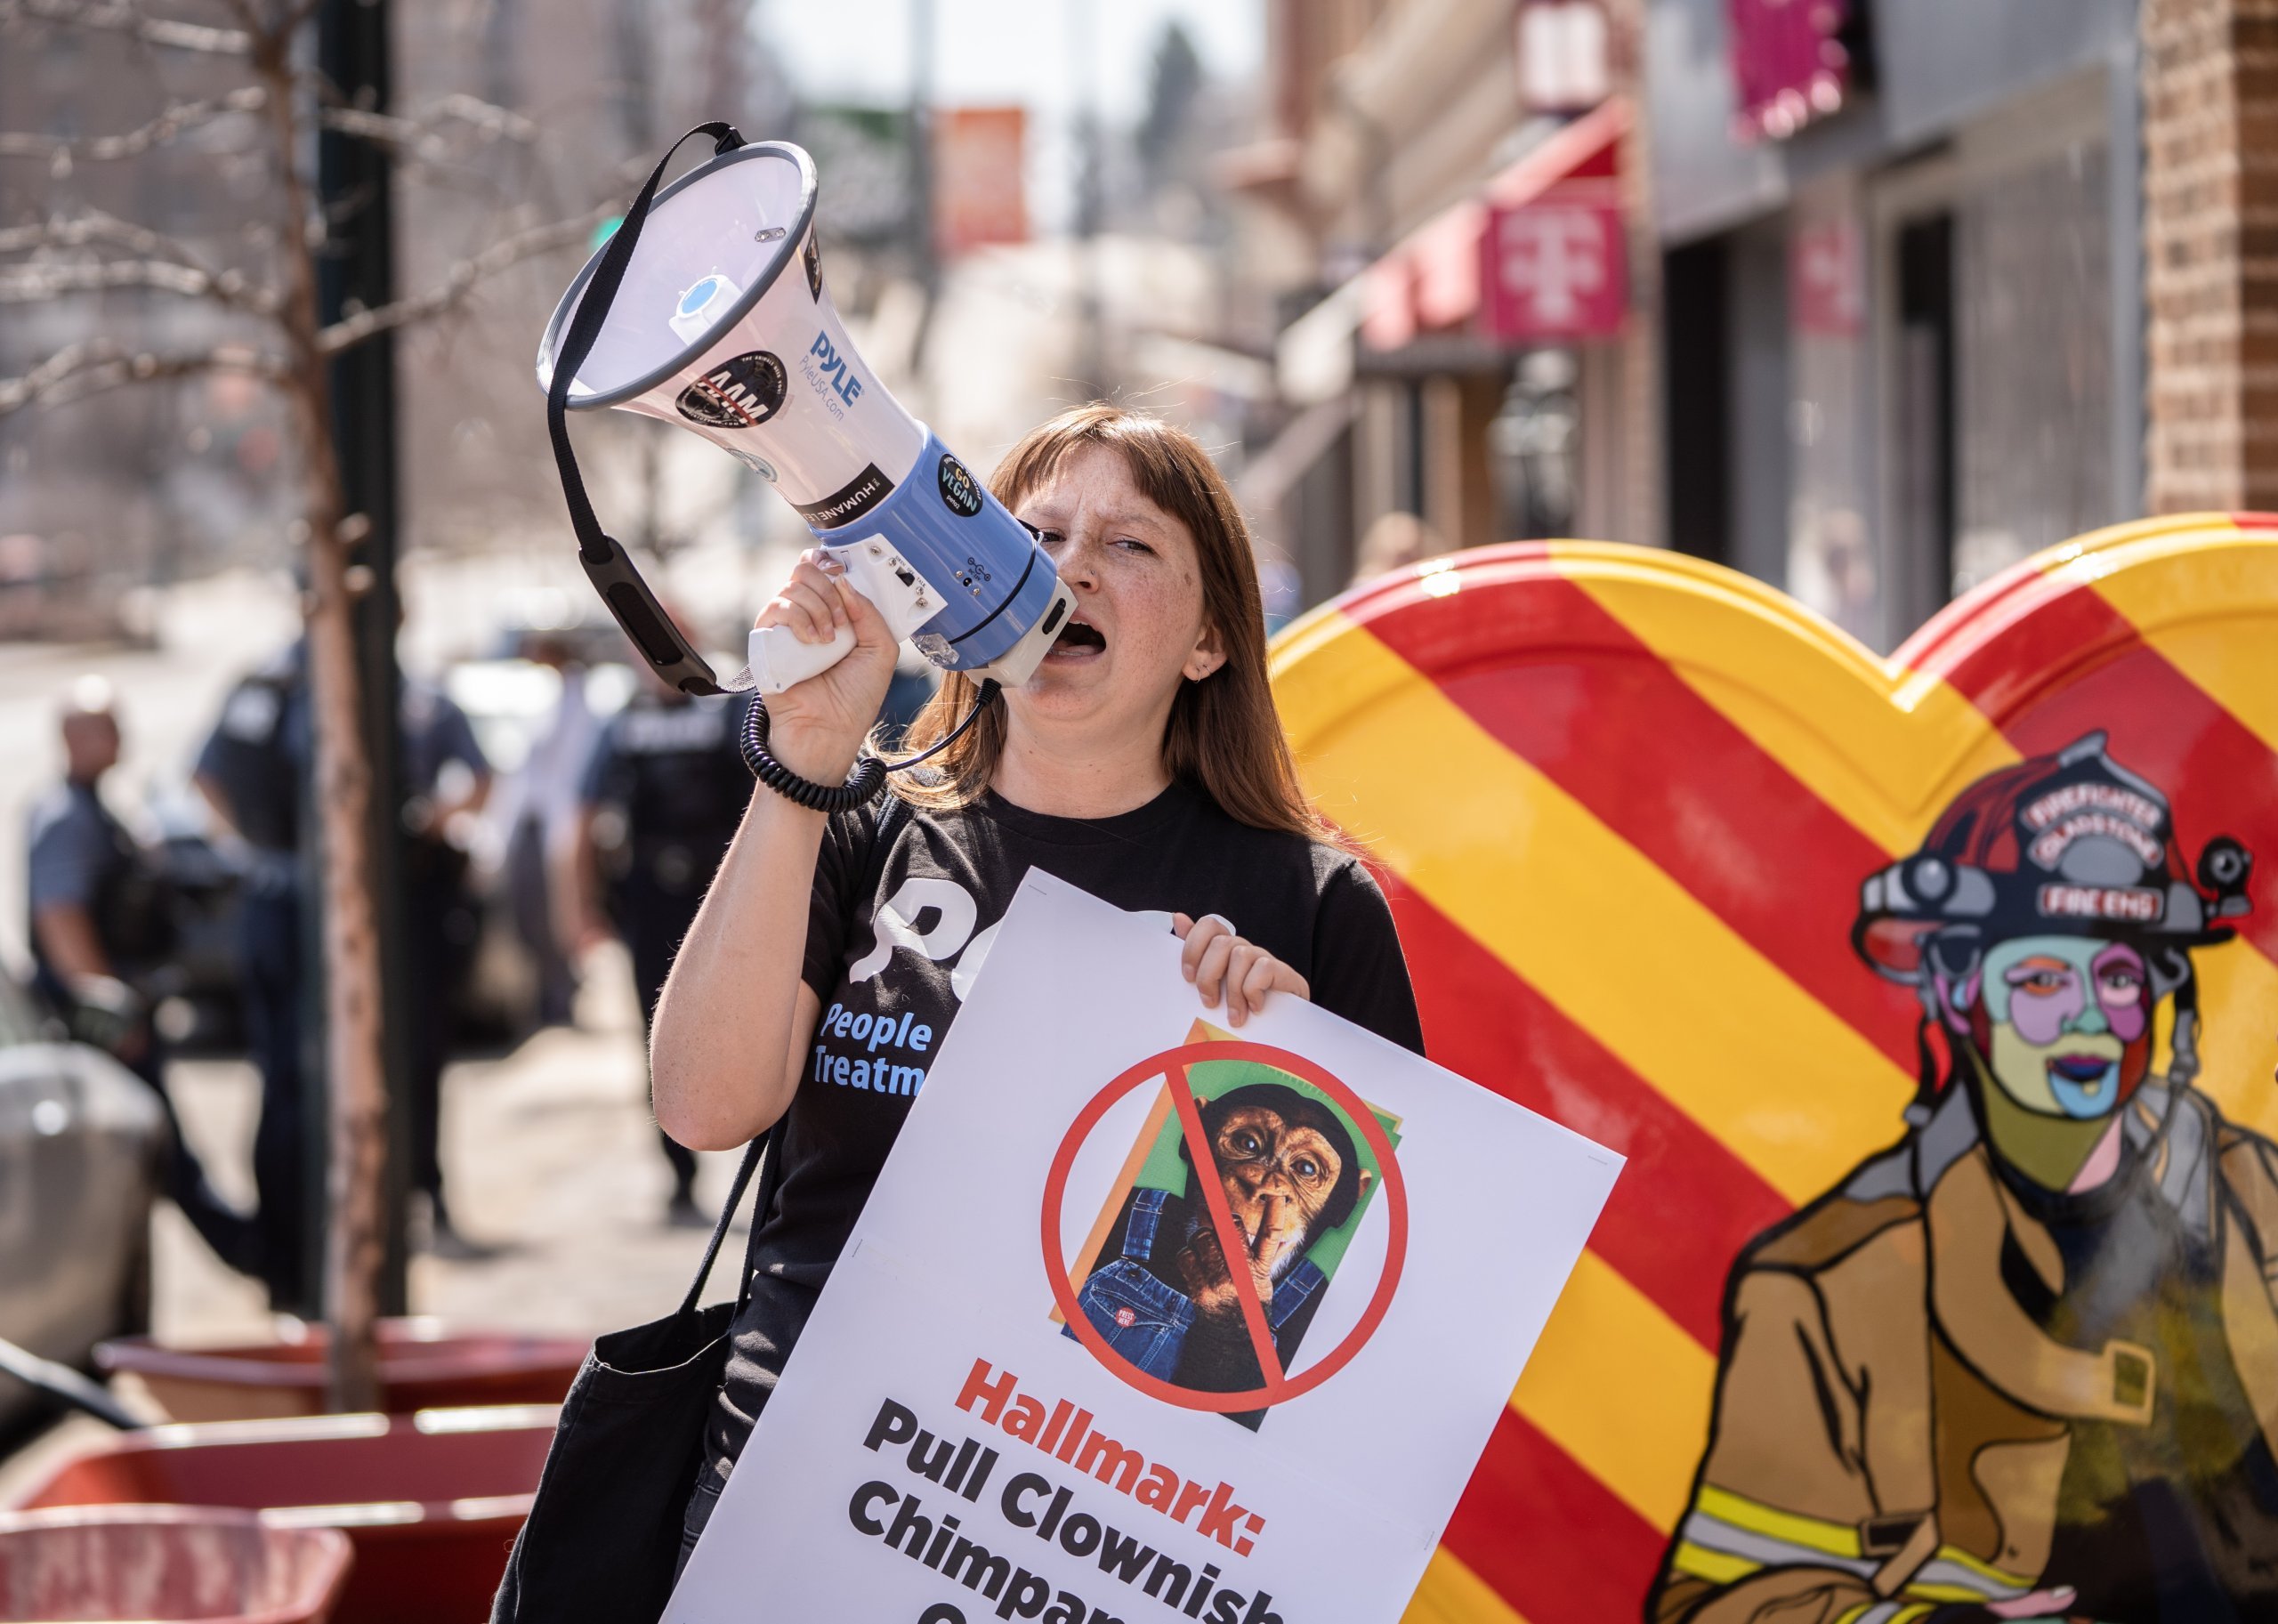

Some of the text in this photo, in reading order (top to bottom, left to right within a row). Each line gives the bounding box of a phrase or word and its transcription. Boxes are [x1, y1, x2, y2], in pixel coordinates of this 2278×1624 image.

[799, 354, 844, 422] PyleUSA.com
[810, 329, 862, 408] PYLE
[697, 370, 770, 425] AAM
[817, 481, 876, 521] HUMANE
[871, 477, 881, 488] THE
[942, 466, 978, 513] VEGAN
[945, 494, 961, 510] peta2
[955, 467, 970, 489] GO
[820, 1002, 933, 1053] People
[1119, 1309, 1135, 1321] PRESS
[862, 1397, 1000, 1504] Pull
[955, 1357, 1266, 1558] Hallmark:
[848, 1480, 1125, 1624] Chimpa
